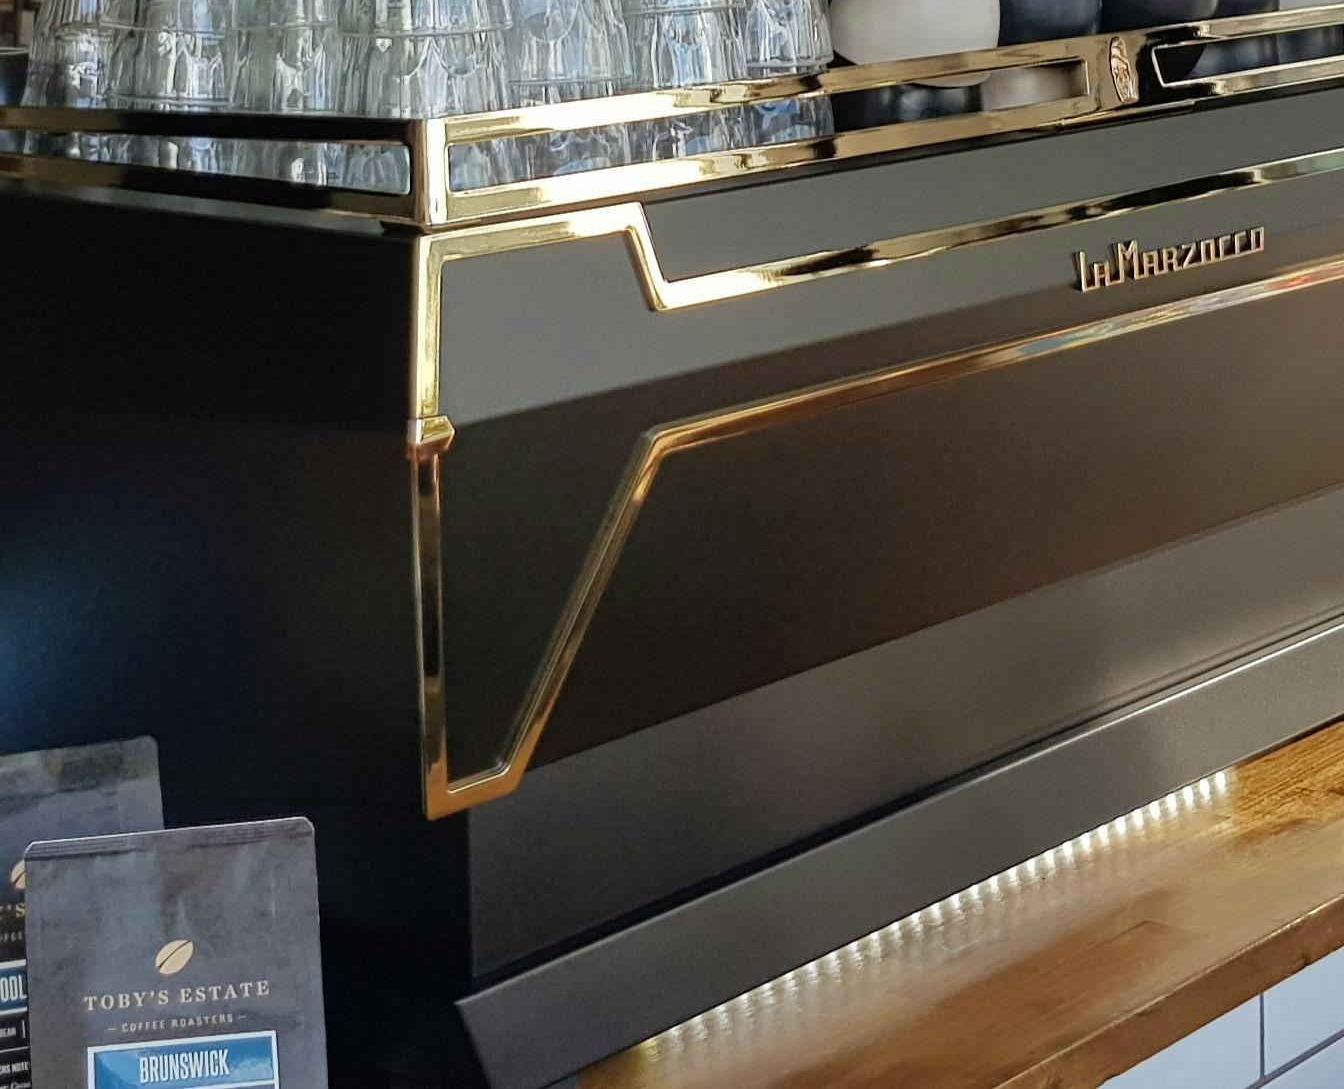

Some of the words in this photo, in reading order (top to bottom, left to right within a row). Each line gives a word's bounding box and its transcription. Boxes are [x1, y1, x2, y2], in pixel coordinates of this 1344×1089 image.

[83, 988, 169, 1012] TOBY'S
[180, 979, 271, 1004] ESTATE
[122, 1019, 167, 1033] COFFEE
[172, 1014, 234, 1029] ROASTERS
[139, 1048, 230, 1085] BRUNSWICK
